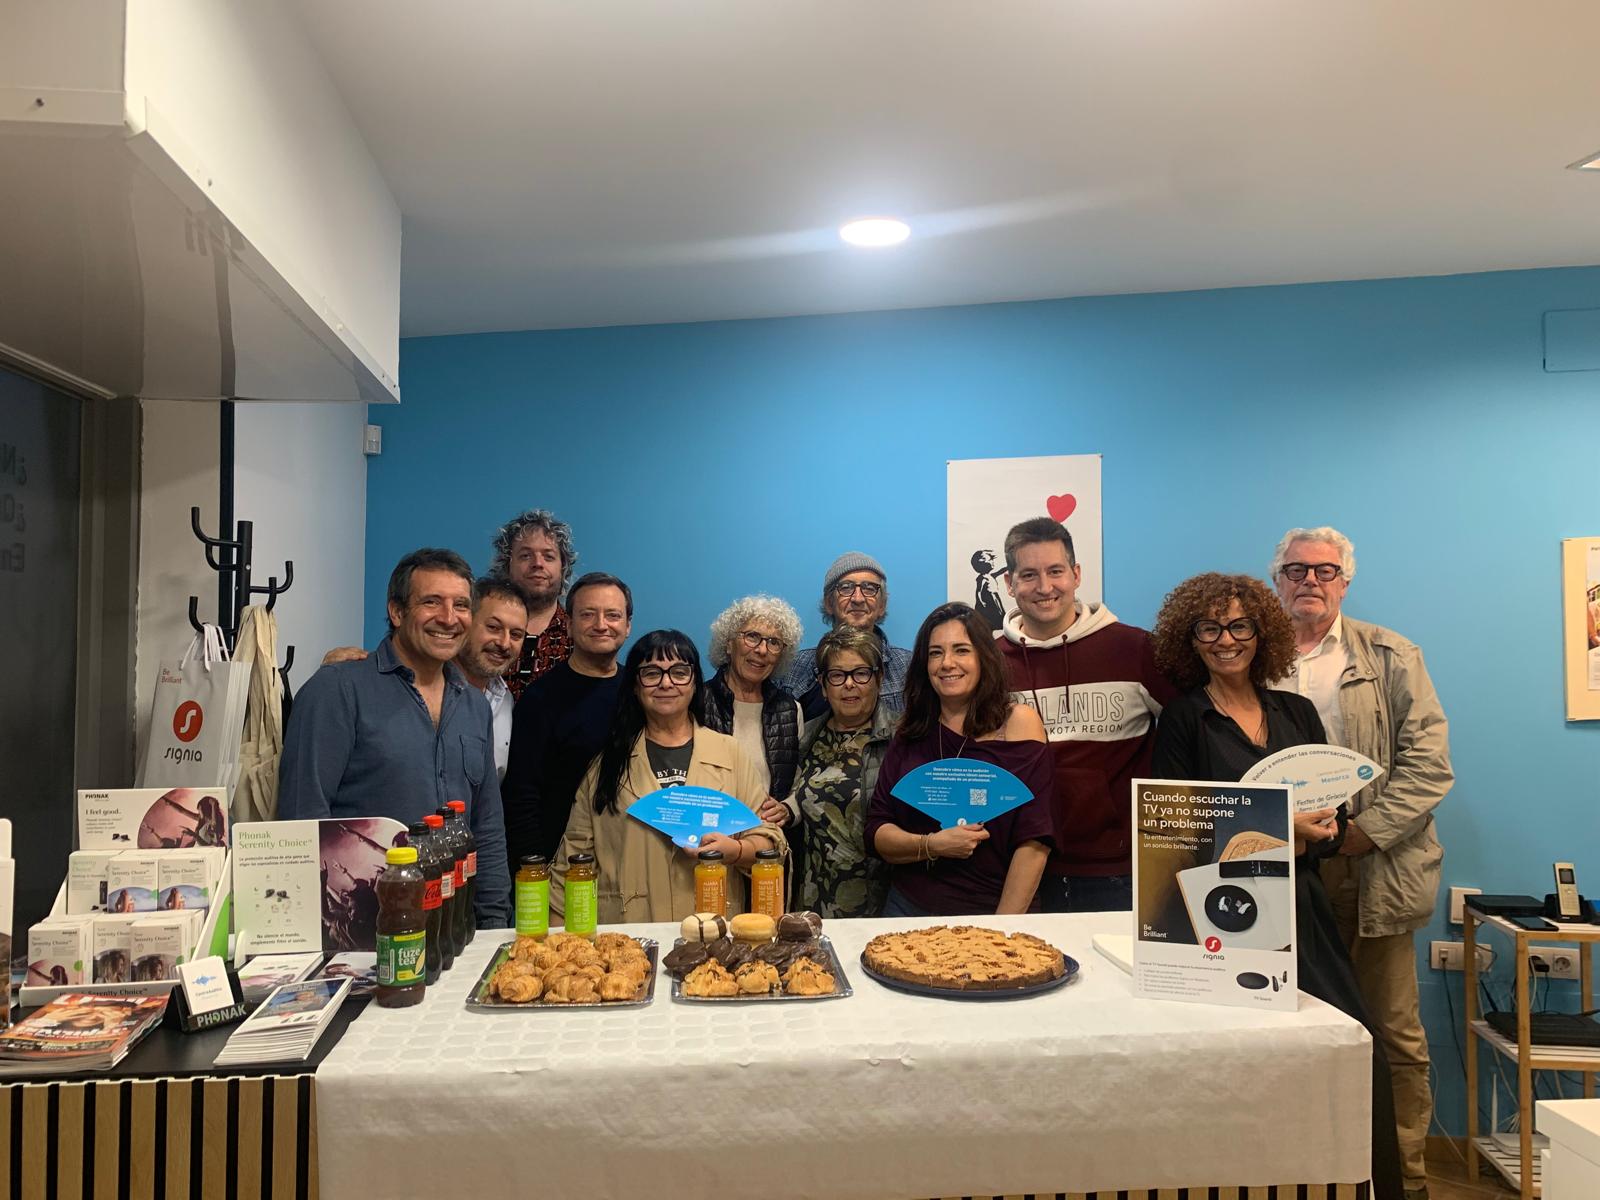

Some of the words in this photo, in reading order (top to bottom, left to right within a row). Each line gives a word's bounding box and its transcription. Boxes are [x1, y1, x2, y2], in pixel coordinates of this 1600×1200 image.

[162, 668, 171, 676] Be
[161, 676, 183, 684] Brilliant
[1081, 724, 1123, 734] REGION
[163, 747, 203, 765] signia
[1271, 753, 1297, 766] entender
[1308, 750, 1357, 762] conversaciones
[656, 769, 669, 778] BY
[1143, 791, 1186, 802] Cuando
[1189, 794, 1239, 805] escuchar
[1241, 795, 1251, 805] la
[1143, 804, 1158, 814] TV
[1160, 807, 1173, 816] ya
[1175, 808, 1190, 816] no
[1192, 808, 1235, 819] supone
[1143, 819, 1157, 827] un
[1159, 819, 1214, 830] problema
[239, 831, 272, 840] Phonak
[239, 840, 276, 850] Serenity
[1143, 931, 1168, 939] Brilliant
[398, 947, 421, 958] fuze
[1202, 953, 1225, 961] signia
[398, 956, 416, 966] tea
[196, 1004, 247, 1028] PHONAK
